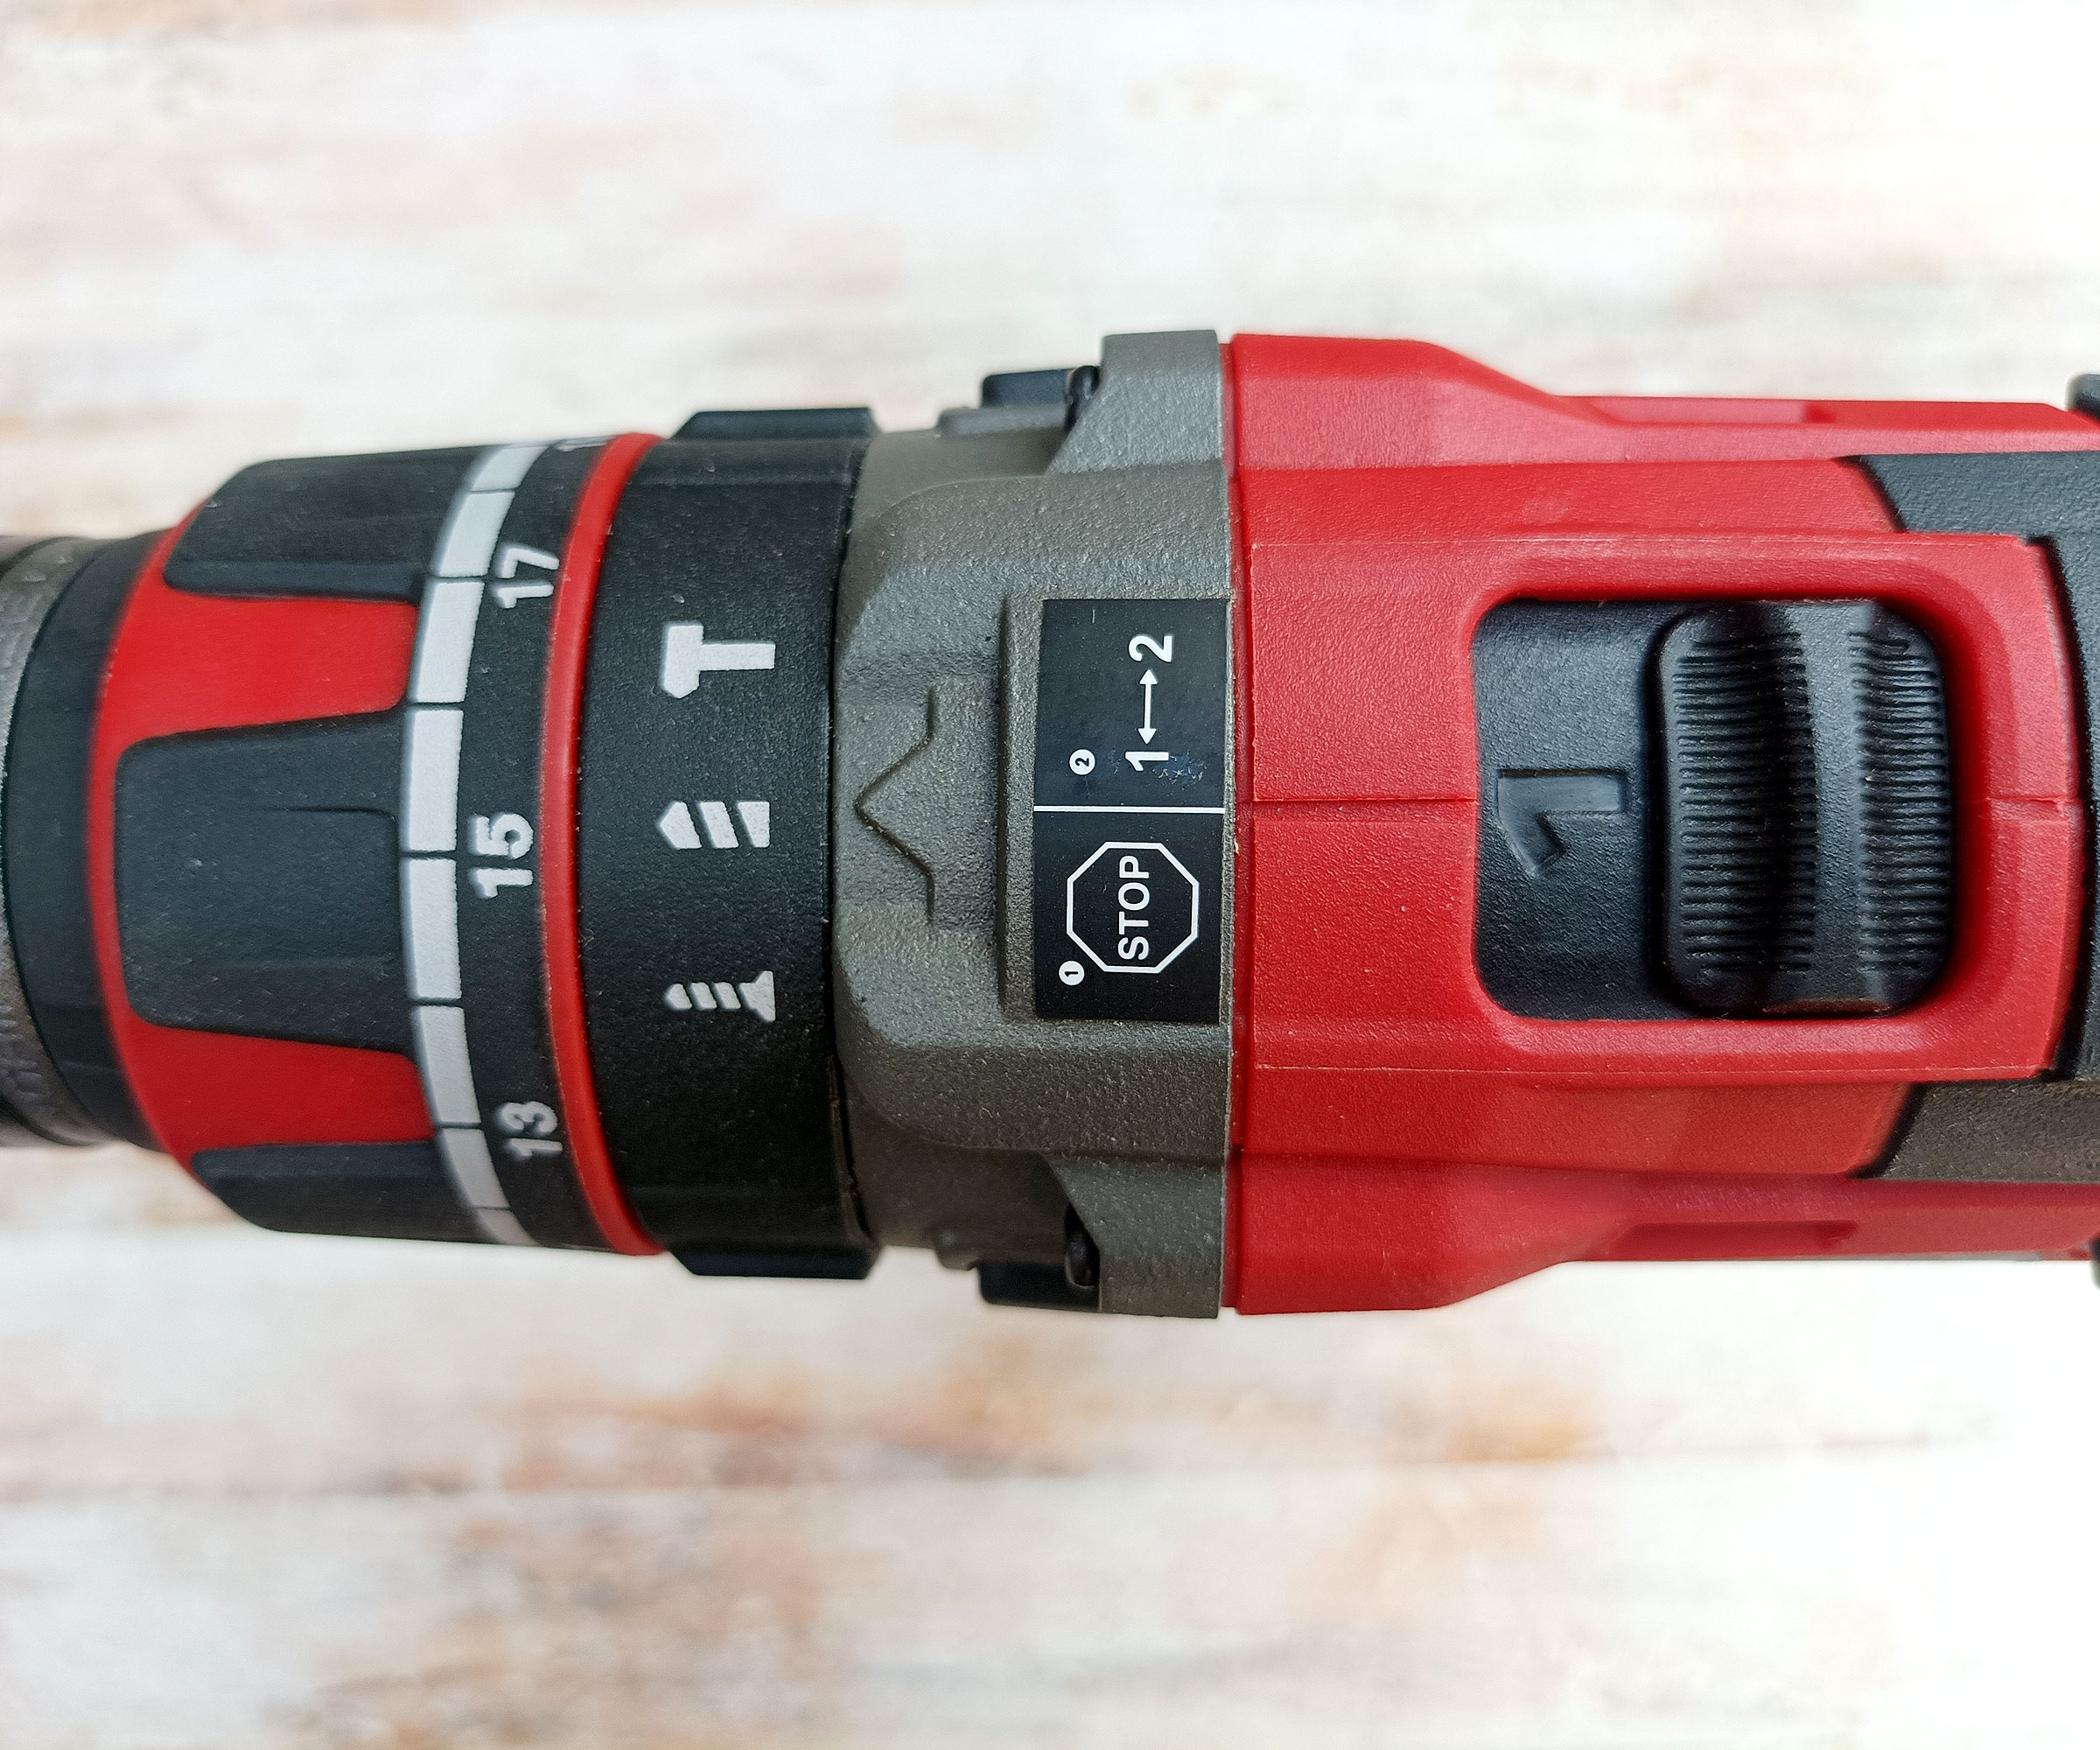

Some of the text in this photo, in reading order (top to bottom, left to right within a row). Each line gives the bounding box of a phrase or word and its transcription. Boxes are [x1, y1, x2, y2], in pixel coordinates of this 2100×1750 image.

[494, 542, 560, 609] 17
[1125, 634, 1174, 772] 1 2
[469, 813, 534, 899] 15
[1117, 855, 1151, 962] STOP
[496, 1101, 564, 1161] 13
